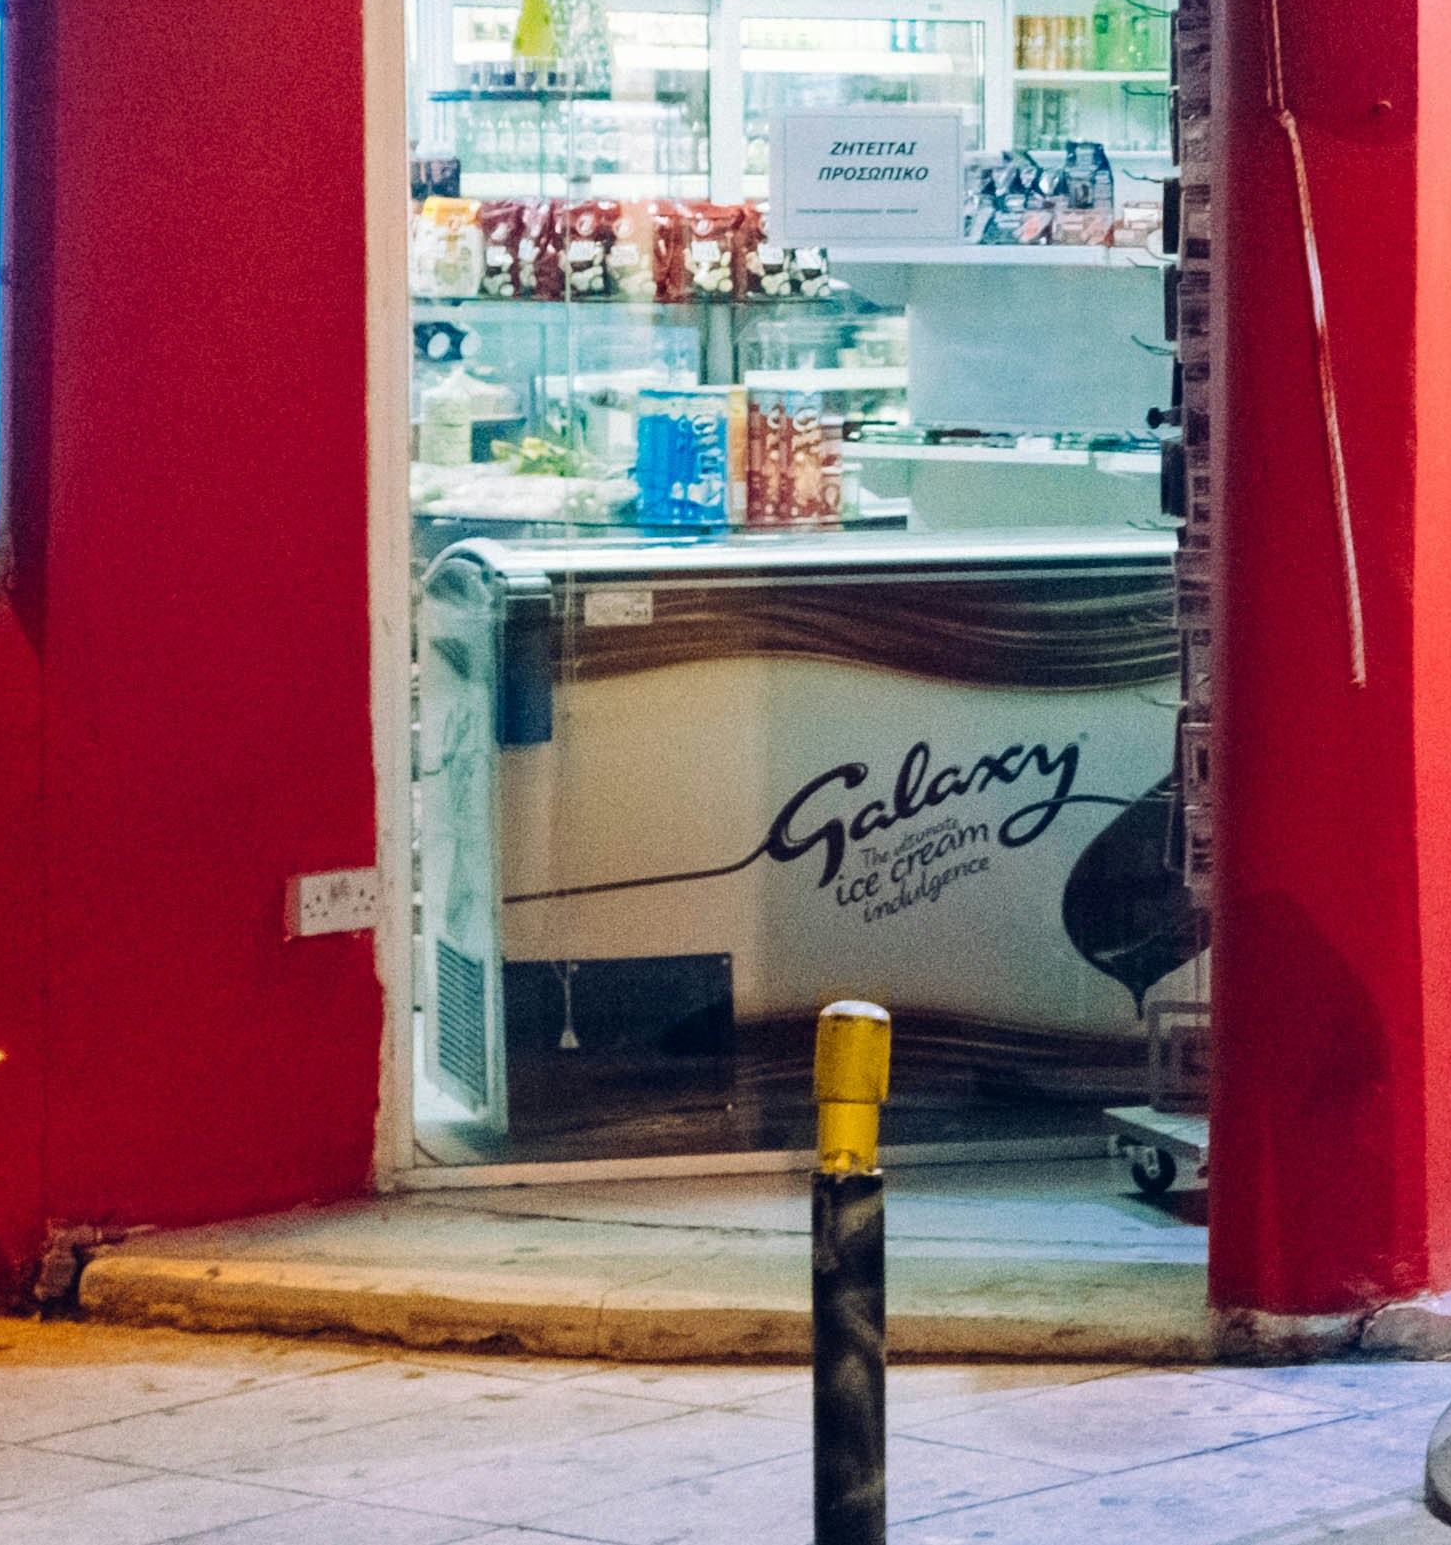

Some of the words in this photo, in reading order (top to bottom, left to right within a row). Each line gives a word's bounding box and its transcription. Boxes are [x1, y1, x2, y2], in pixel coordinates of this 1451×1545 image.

[818, 166, 929, 181] ΠΡΟΣΩΠΙΚΟ
[829, 141, 917, 156] ΖΗΤΕΙΤΑΙ
[763, 740, 1079, 889] Galaxy
[835, 871, 881, 907] ice
[890, 822, 990, 883] cream
[863, 854, 992, 923] indulgence
